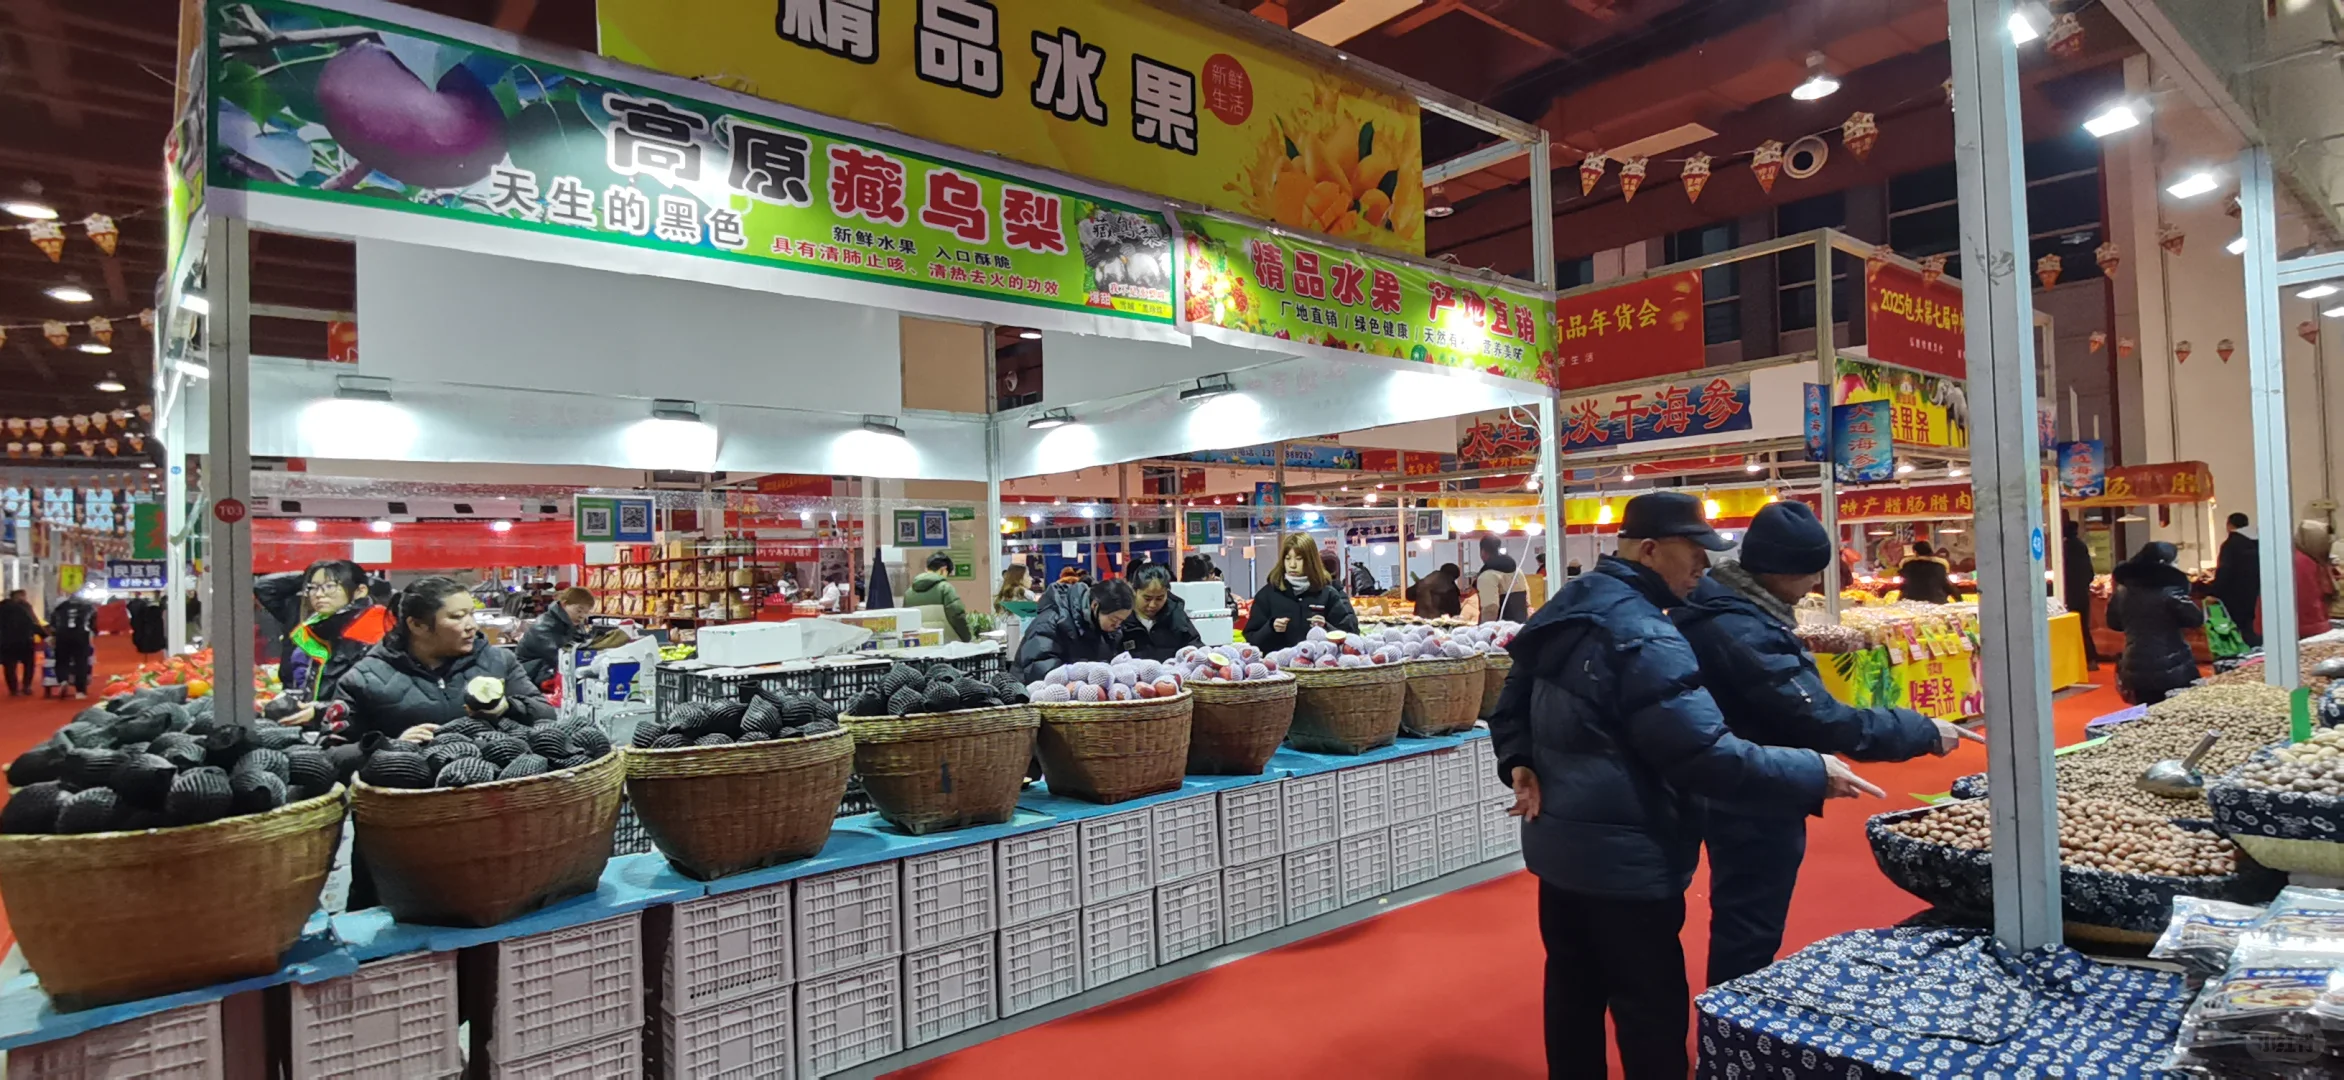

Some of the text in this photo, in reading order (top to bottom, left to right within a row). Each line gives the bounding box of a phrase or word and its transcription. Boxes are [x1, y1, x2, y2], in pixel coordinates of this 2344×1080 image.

[776, 0, 1198, 154] 精品水果
[1211, 64, 1245, 92] 新鲜
[1212, 88, 1245, 116] 生活
[605, 96, 1066, 253] 高原藏乌梨
[491, 168, 745, 246] 天生的黑色
[771, 235, 1060, 296] 具有清肺止咳、清热去火的功效
[832, 226, 1012, 270] 新鲜水果 入口酥脆
[1250, 238, 1537, 344] 精品水果 产地直销
[1280, 301, 1338, 330] 厂地直销
[1354, 313, 1409, 341] 绿色健康
[1424, 327, 1470, 354] 天然有
[1462, 377, 1744, 457] 大连淡干海参
[1848, 403, 1878, 469] 大连海参
[218, 505, 243, 516] T03
[1840, 490, 1973, 517] 特产腊肠腊肉
